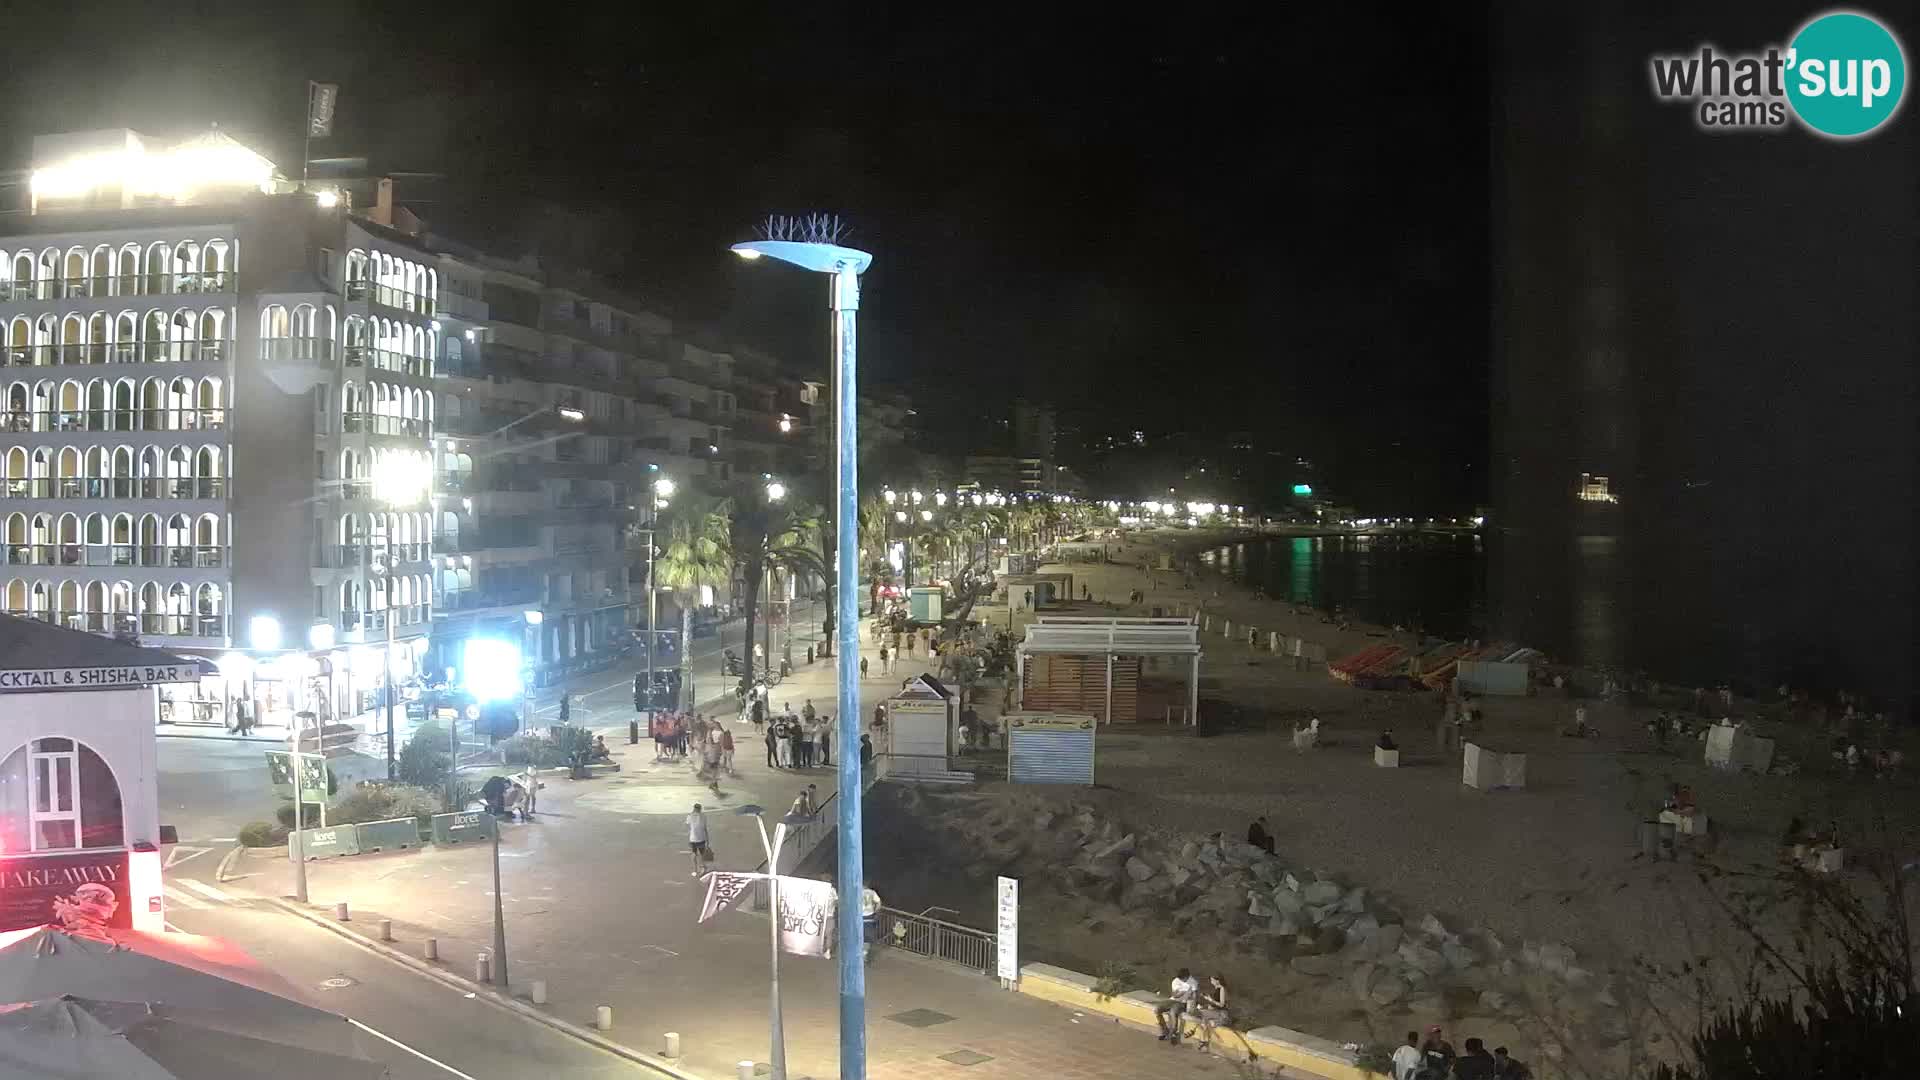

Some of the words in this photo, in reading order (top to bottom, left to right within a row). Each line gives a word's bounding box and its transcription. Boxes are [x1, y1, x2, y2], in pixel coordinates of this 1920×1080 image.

[63, 670, 74, 684] &
[80, 668, 142, 684] SHISHA
[145, 667, 178, 681] BAR
